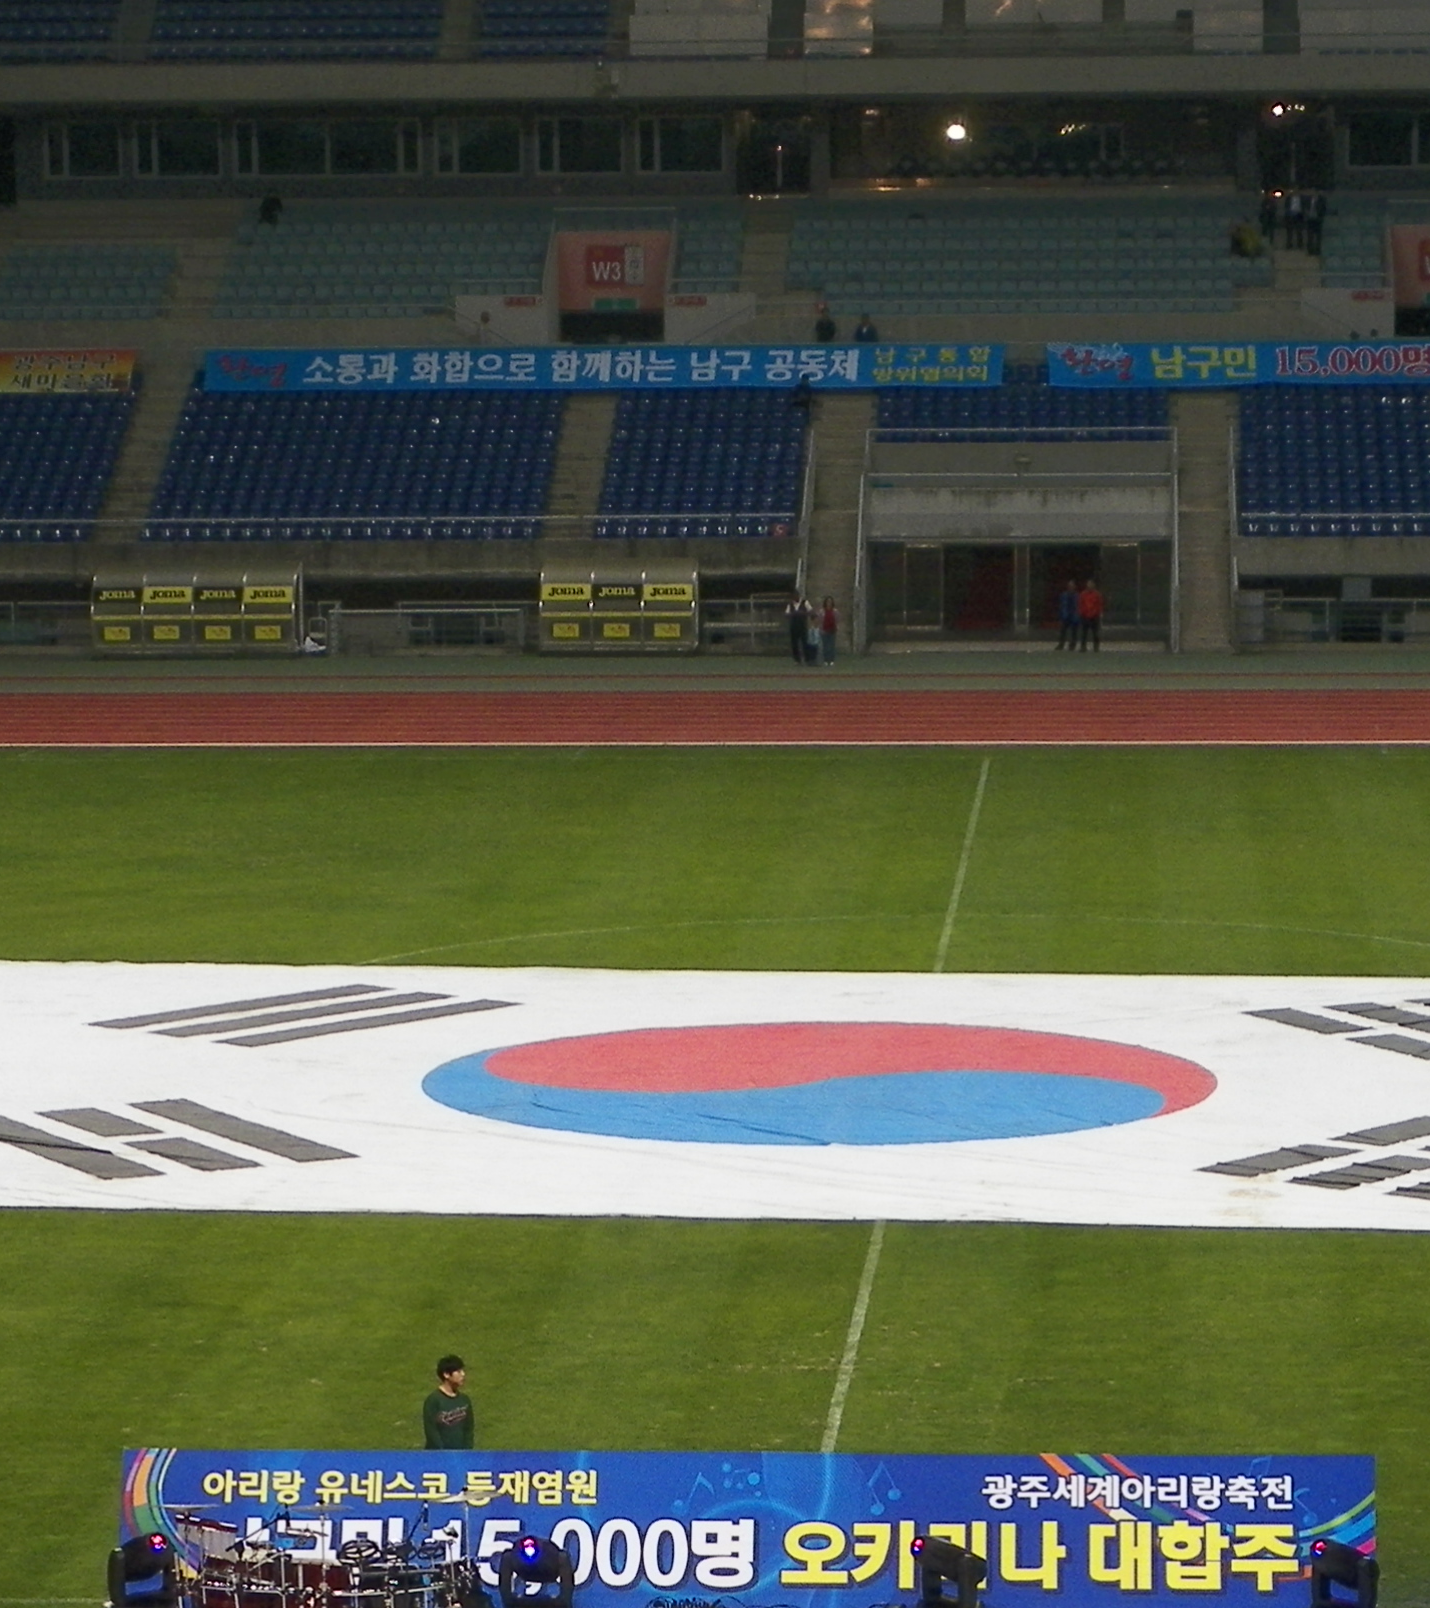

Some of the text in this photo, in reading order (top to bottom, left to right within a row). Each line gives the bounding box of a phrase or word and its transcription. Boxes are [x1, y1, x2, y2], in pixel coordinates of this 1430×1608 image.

[592, 261, 621, 281] W3
[301, 347, 860, 384] 소통과 화합으로 함께하는 남구 공동체
[1150, 344, 1258, 381] 남구민
[202, 1468, 599, 1505] 아리랑 유네스코 등재염원
[980, 1474, 1296, 1511] 광주세계아리랑축전
[1087, 1517, 1300, 1591] 대합주
